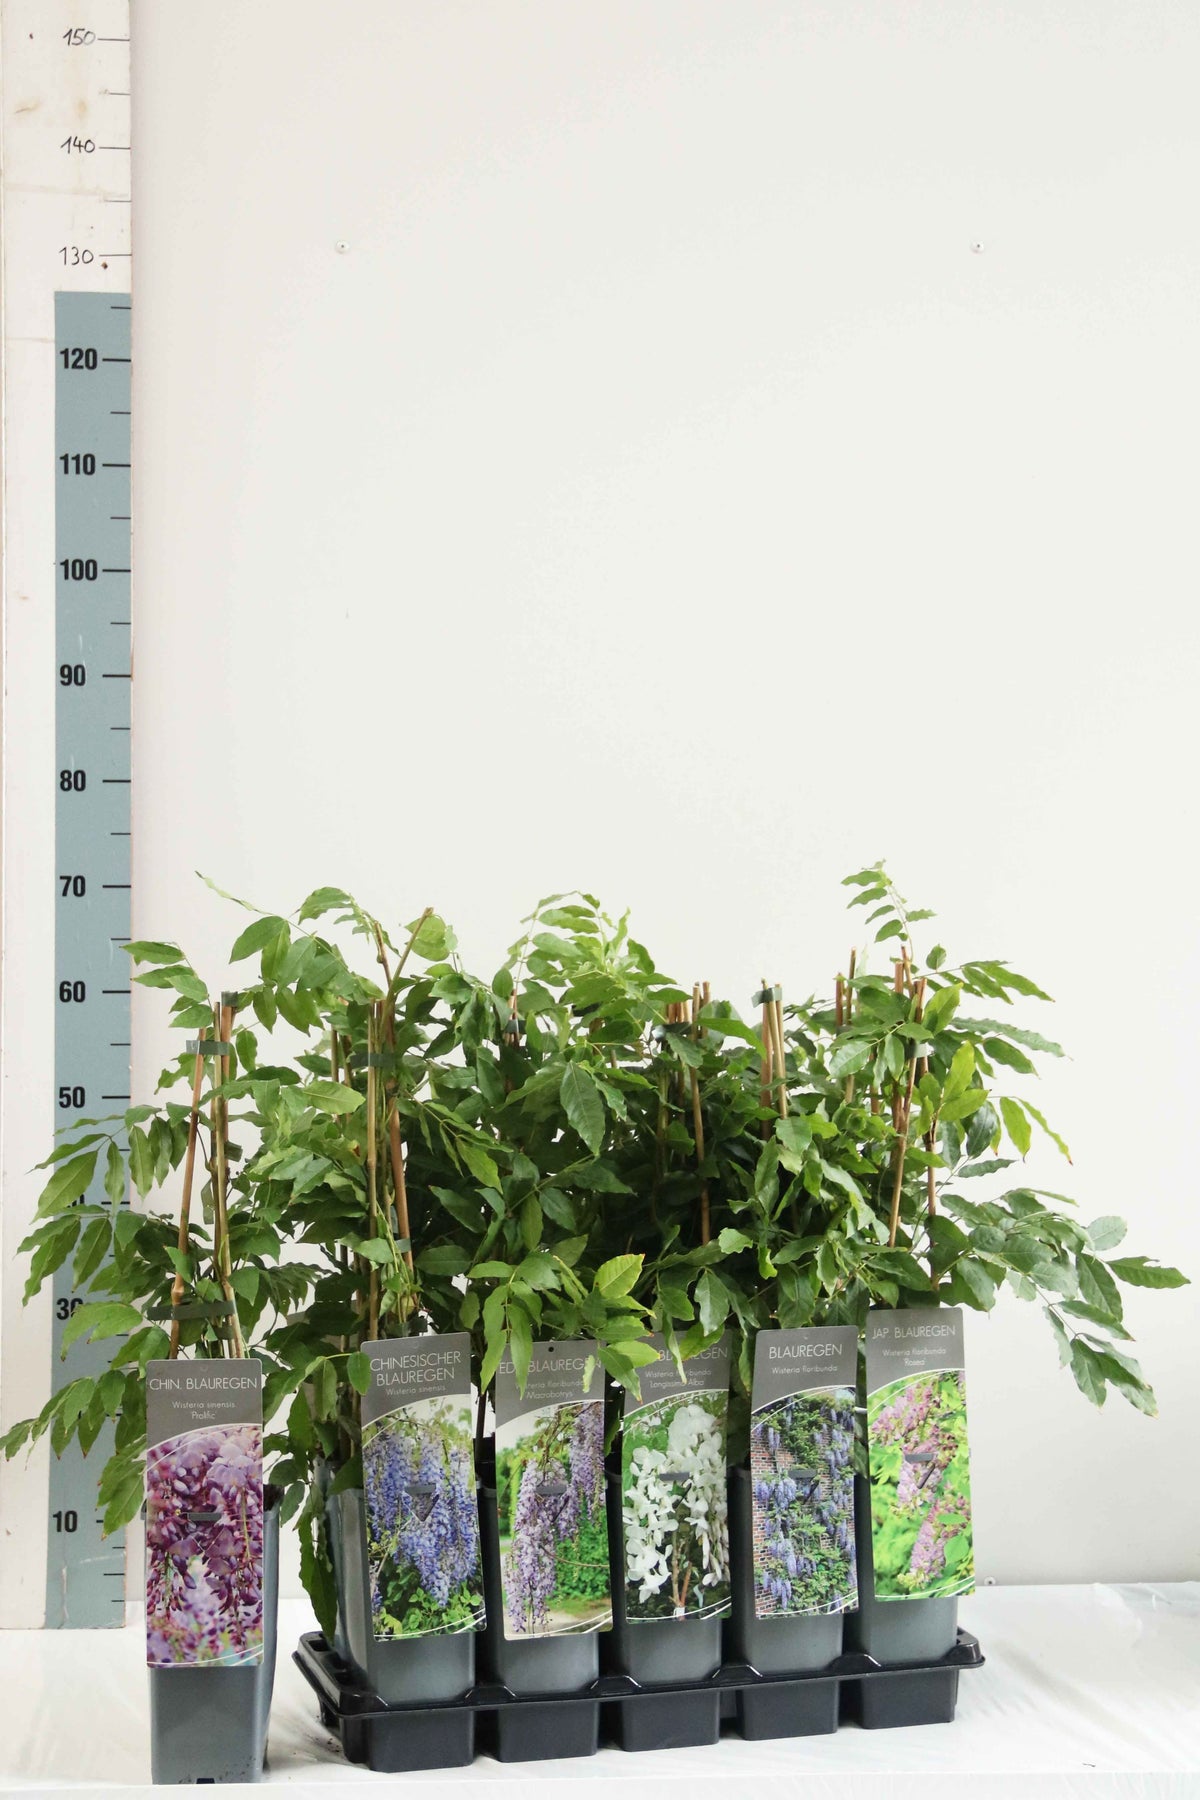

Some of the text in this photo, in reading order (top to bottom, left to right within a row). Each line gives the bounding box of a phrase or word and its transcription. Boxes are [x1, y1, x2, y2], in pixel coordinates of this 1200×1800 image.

[63, 27, 97, 46] 150
[60, 136, 96, 154] 140
[59, 245, 95, 266] 130
[59, 348, 98, 371] 120
[59, 453, 96, 476] 110
[59, 558, 98, 581] 100
[59, 664, 87, 687] 90
[59, 769, 87, 792] 80
[59, 875, 86, 897] 70
[59, 980, 86, 1003] 60
[58, 1085, 86, 1108] 50
[894, 1324, 956, 1339] BLAUREGEN
[369, 1350, 462, 1372] CHINESISCHER
[769, 1343, 843, 1360] BLAUREGEN
[149, 1377, 258, 1391] CHIN. BLAUREGEN
[376, 1366, 455, 1387] BLAUREGEN
[172, 1400, 205, 1409] Wisteria
[52, 1510, 78, 1533] 10
